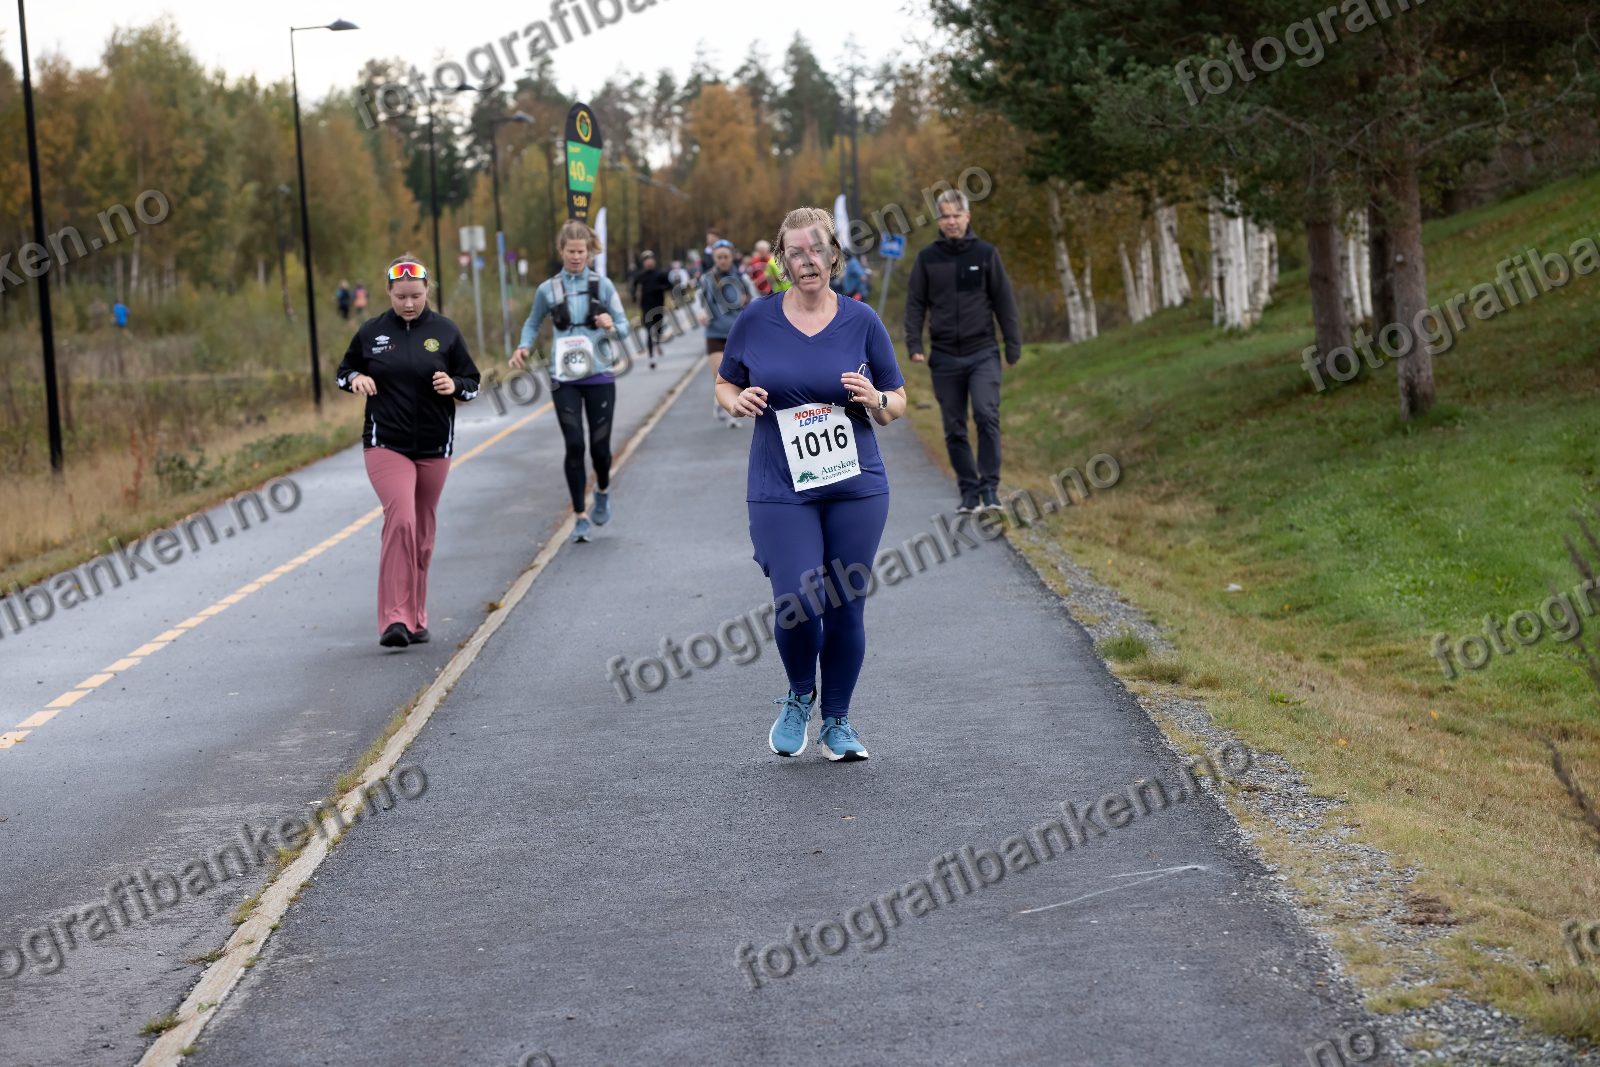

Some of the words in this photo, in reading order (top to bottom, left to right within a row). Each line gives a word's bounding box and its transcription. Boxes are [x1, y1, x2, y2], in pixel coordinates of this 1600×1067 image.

[570, 160, 585, 181] 40
[794, 407, 832, 420] NORGES
[799, 414, 829, 427] LØPET
[791, 425, 848, 460] 1016
[821, 459, 857, 475] Aurskog
